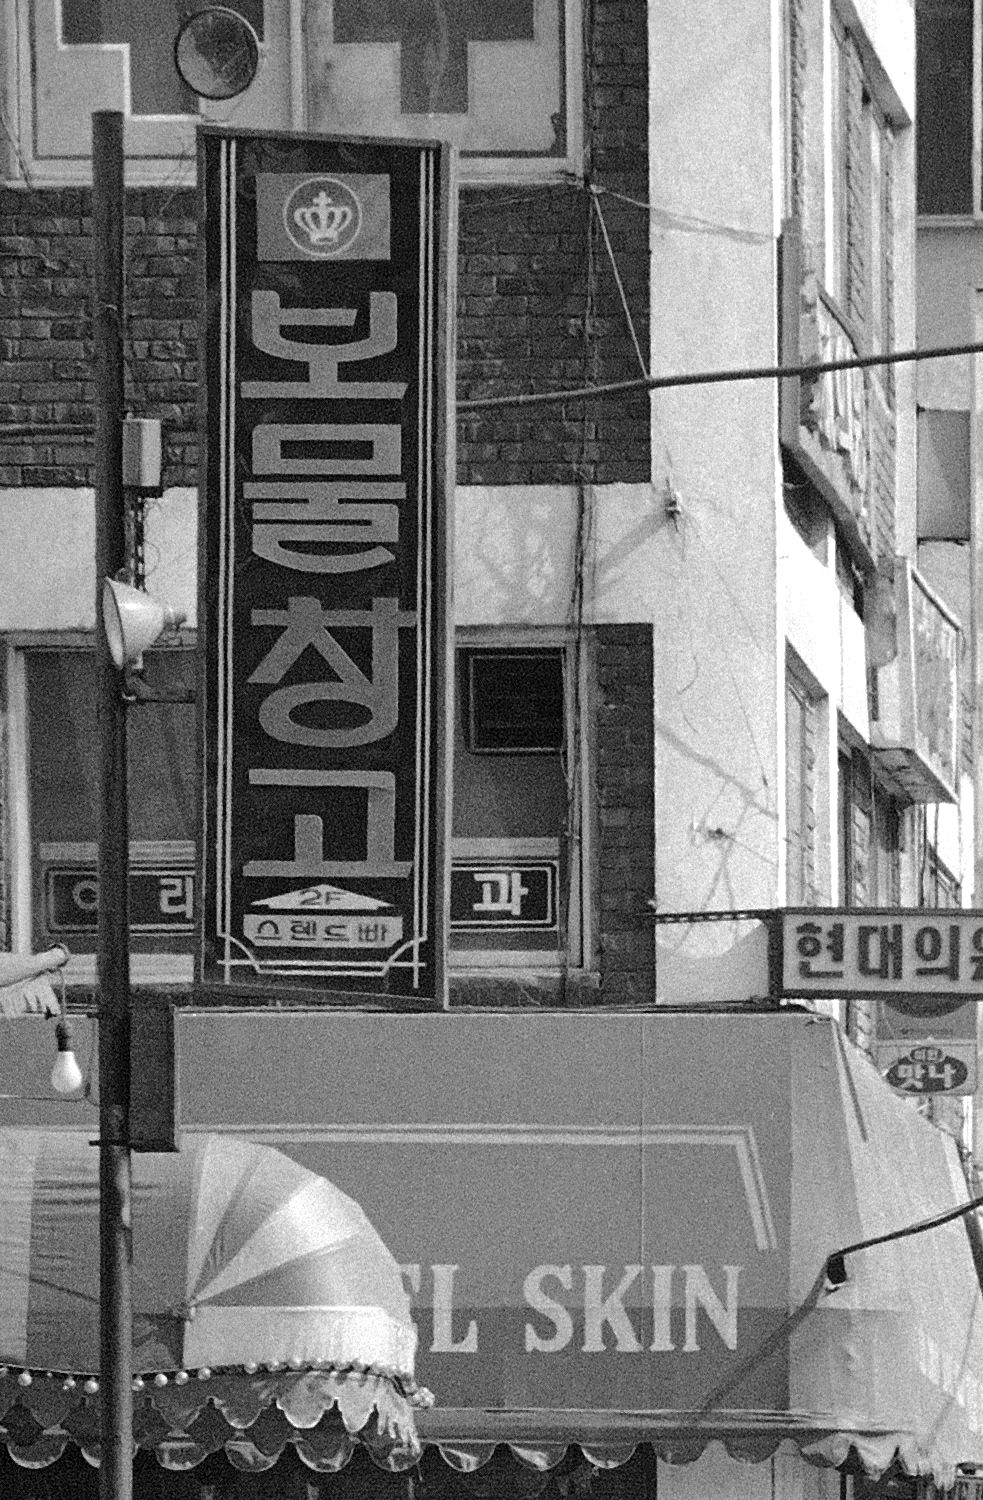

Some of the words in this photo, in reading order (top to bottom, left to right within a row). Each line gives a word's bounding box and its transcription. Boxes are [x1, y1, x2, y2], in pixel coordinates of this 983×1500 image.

[240, 289, 417, 878] 보물창고
[300, 889, 346, 905] 2F
[523, 1264, 744, 1354] SKIN
